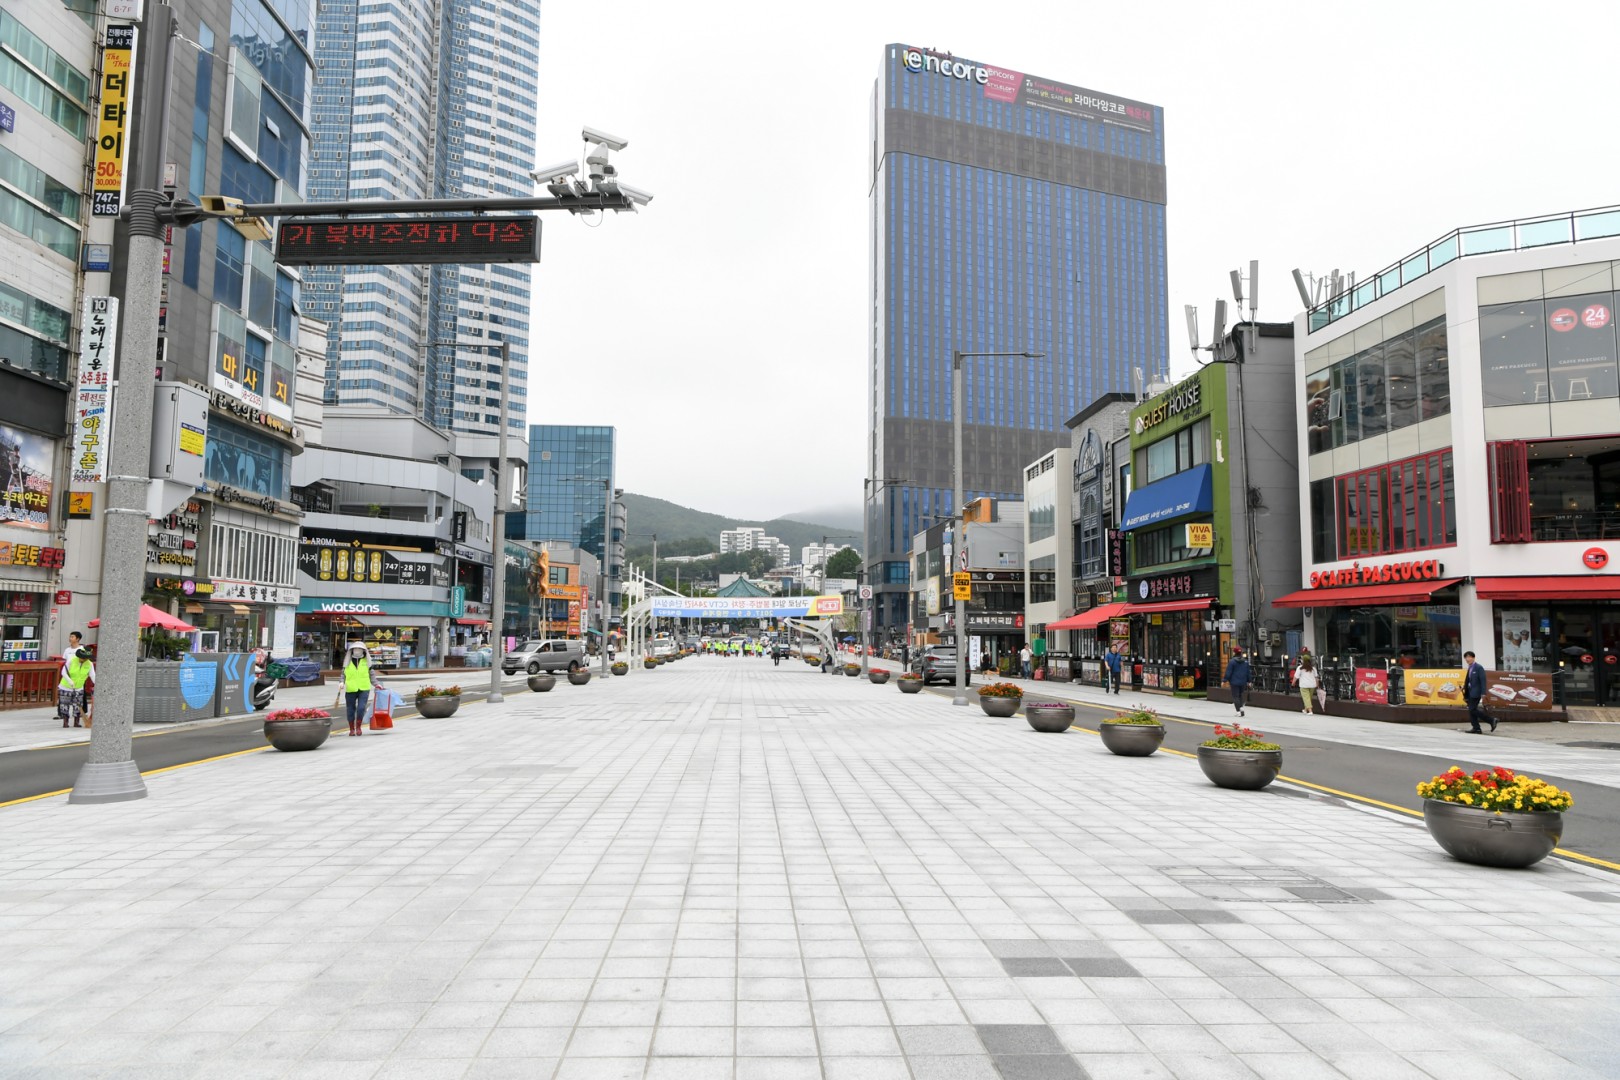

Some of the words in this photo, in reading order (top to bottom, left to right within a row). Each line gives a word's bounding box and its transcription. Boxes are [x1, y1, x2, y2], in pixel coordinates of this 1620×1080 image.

[94, 204, 118, 213] 3153
[1586, 308, 1605, 321] 24
[1143, 401, 1168, 430] GUEST
[1168, 385, 1199, 417] HOUSE
[79, 416, 101, 470] 야구존
[1190, 525, 1210, 534] VIVA
[159, 533, 183, 550] GALLERY
[310, 537, 337, 547] AROMA
[1362, 560, 1440, 583] PASCUCCI
[321, 603, 380, 612] watsons
